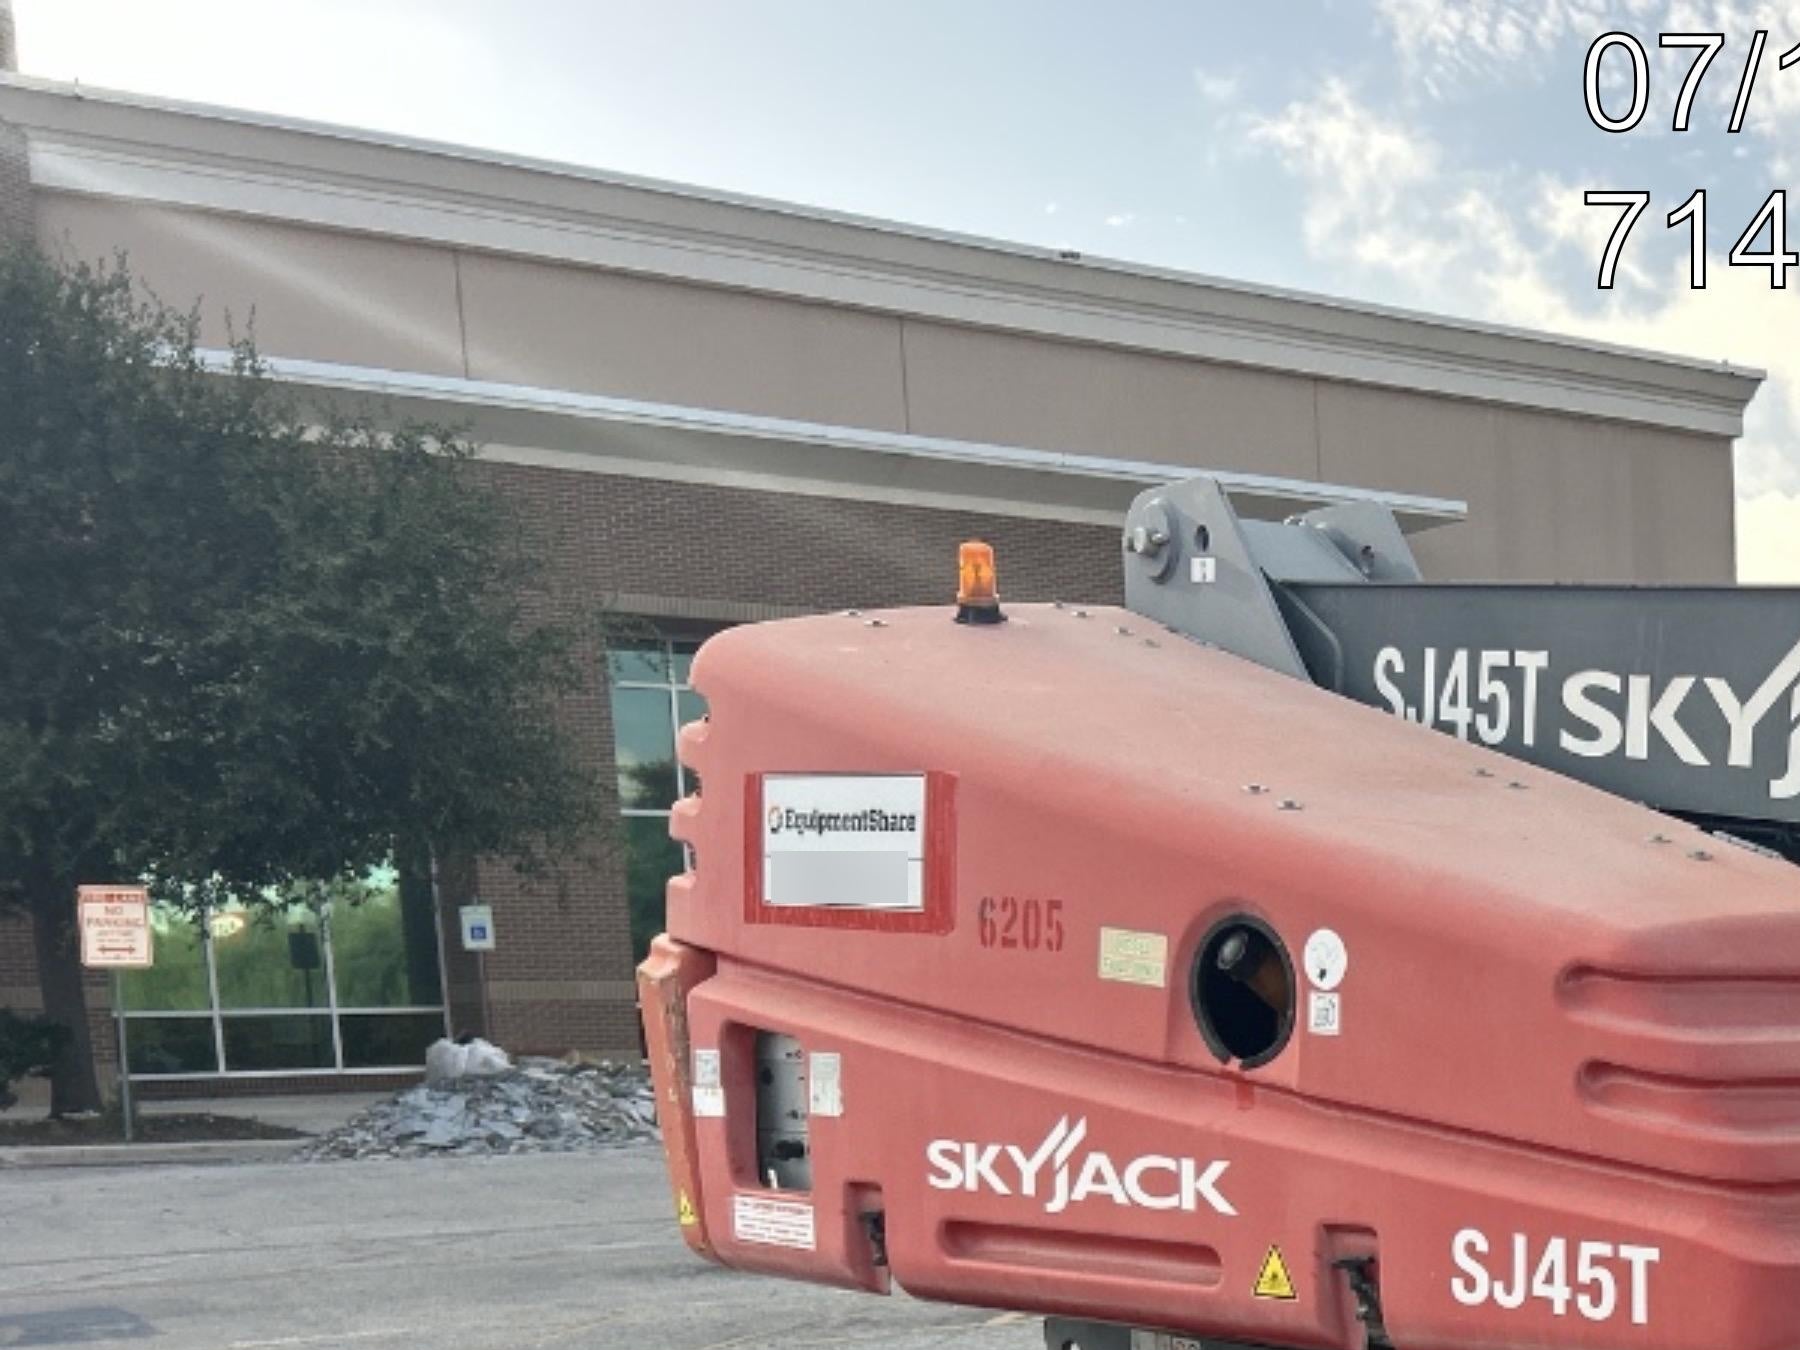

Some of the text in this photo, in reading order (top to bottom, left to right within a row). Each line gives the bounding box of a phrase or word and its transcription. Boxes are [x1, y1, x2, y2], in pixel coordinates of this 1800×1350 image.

[1373, 645, 1550, 747] SJ45T
[784, 807, 917, 836] EquipmentShare
[977, 895, 1065, 953] 6205
[926, 1113, 1240, 1216] SKYJACK
[1451, 1227, 1661, 1325] SJ45T
